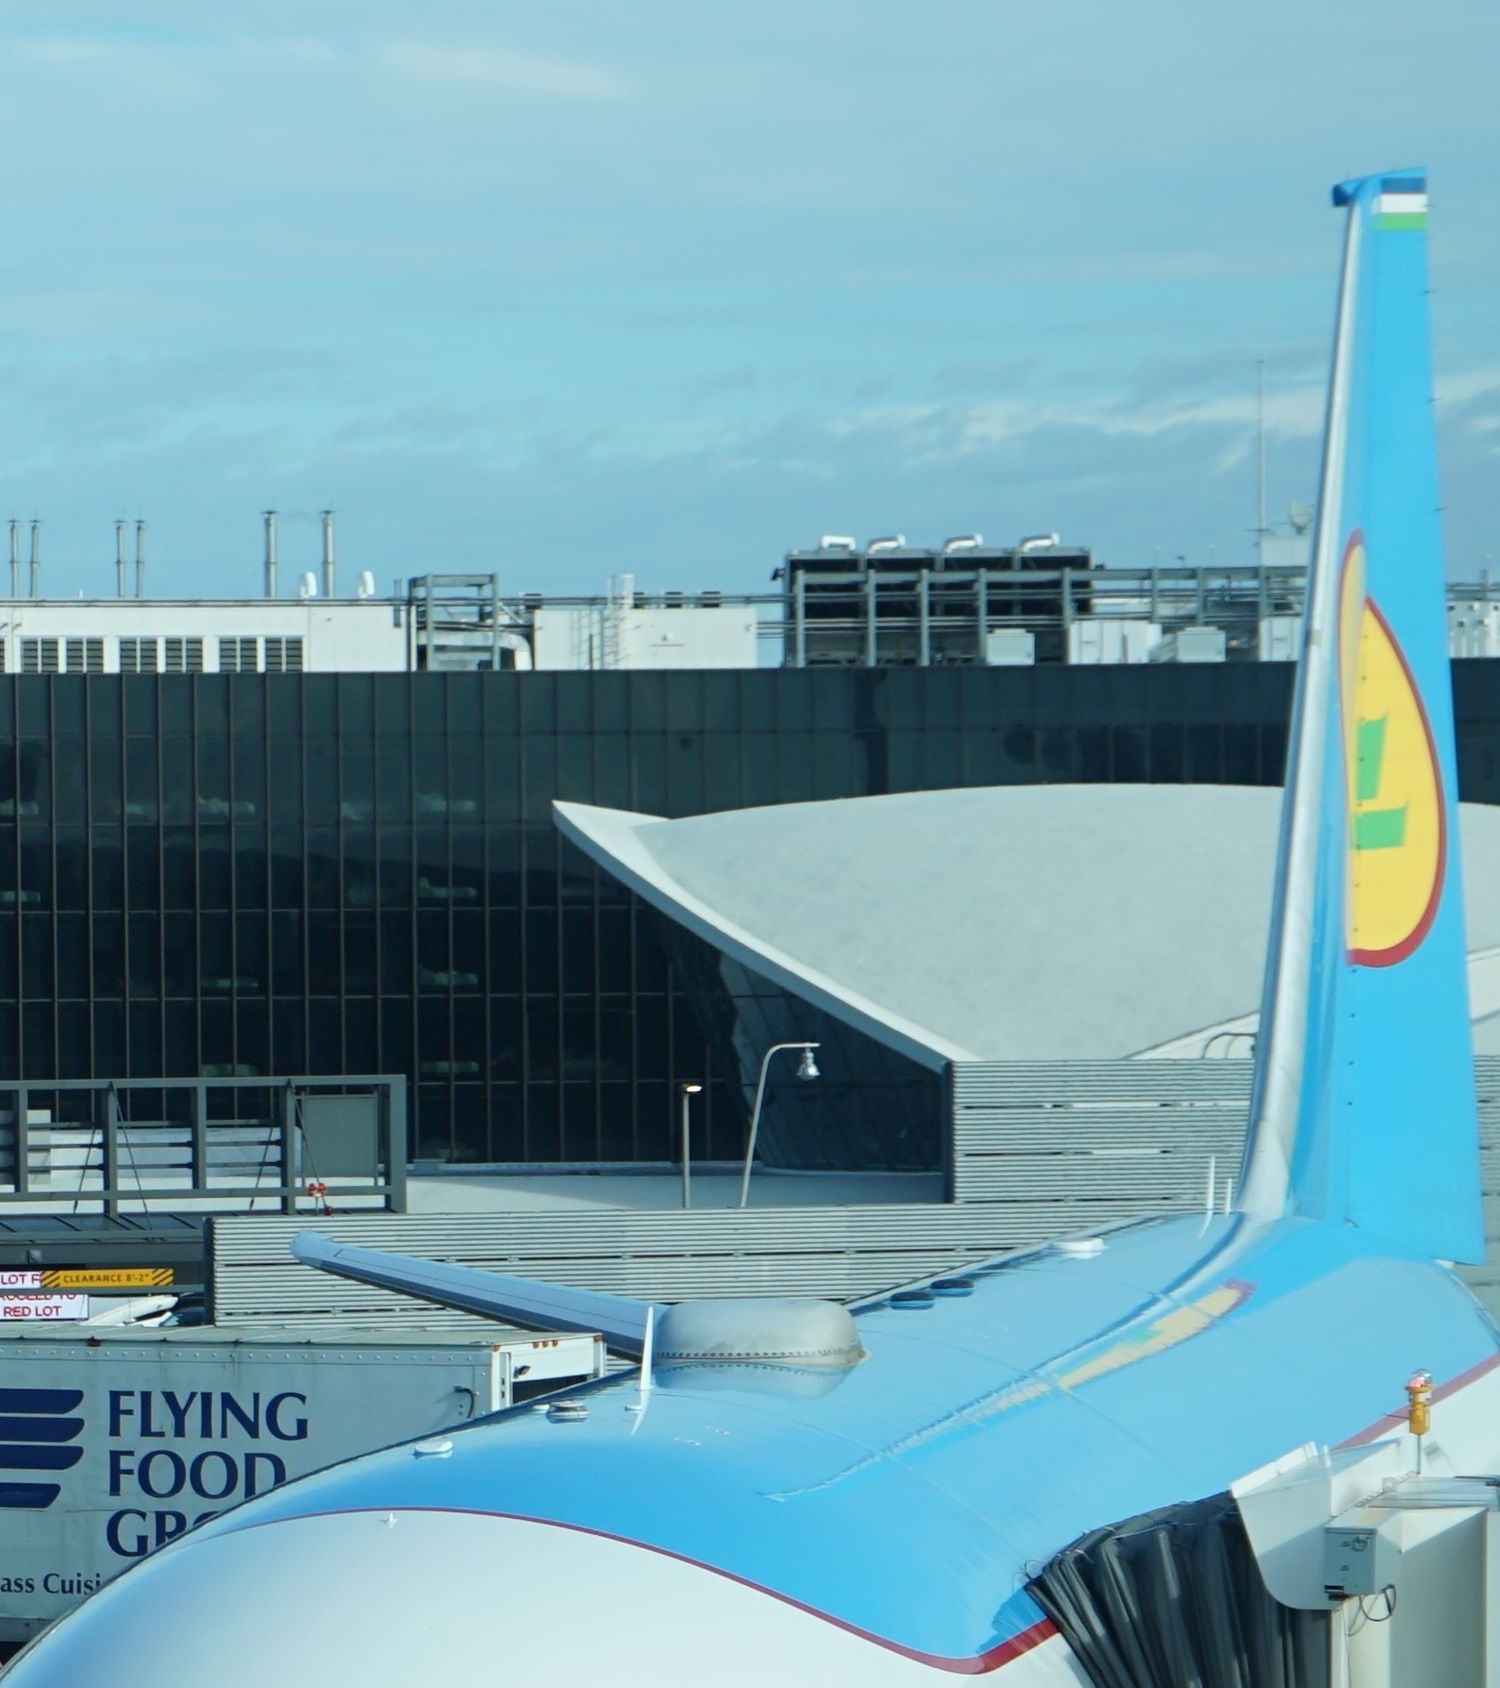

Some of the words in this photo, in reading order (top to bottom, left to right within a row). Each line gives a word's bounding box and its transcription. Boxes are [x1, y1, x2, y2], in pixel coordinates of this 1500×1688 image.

[0, 1273, 27, 1285] LOT
[62, 1273, 121, 1284] CLEARANCE
[3, 1306, 31, 1317] RED
[35, 1306, 62, 1317] LOT
[108, 1390, 308, 1441] FLYING
[108, 1450, 286, 1499] FOOD
[106, 1508, 221, 1557] GR
[43, 1571, 101, 1596] Cuisi
